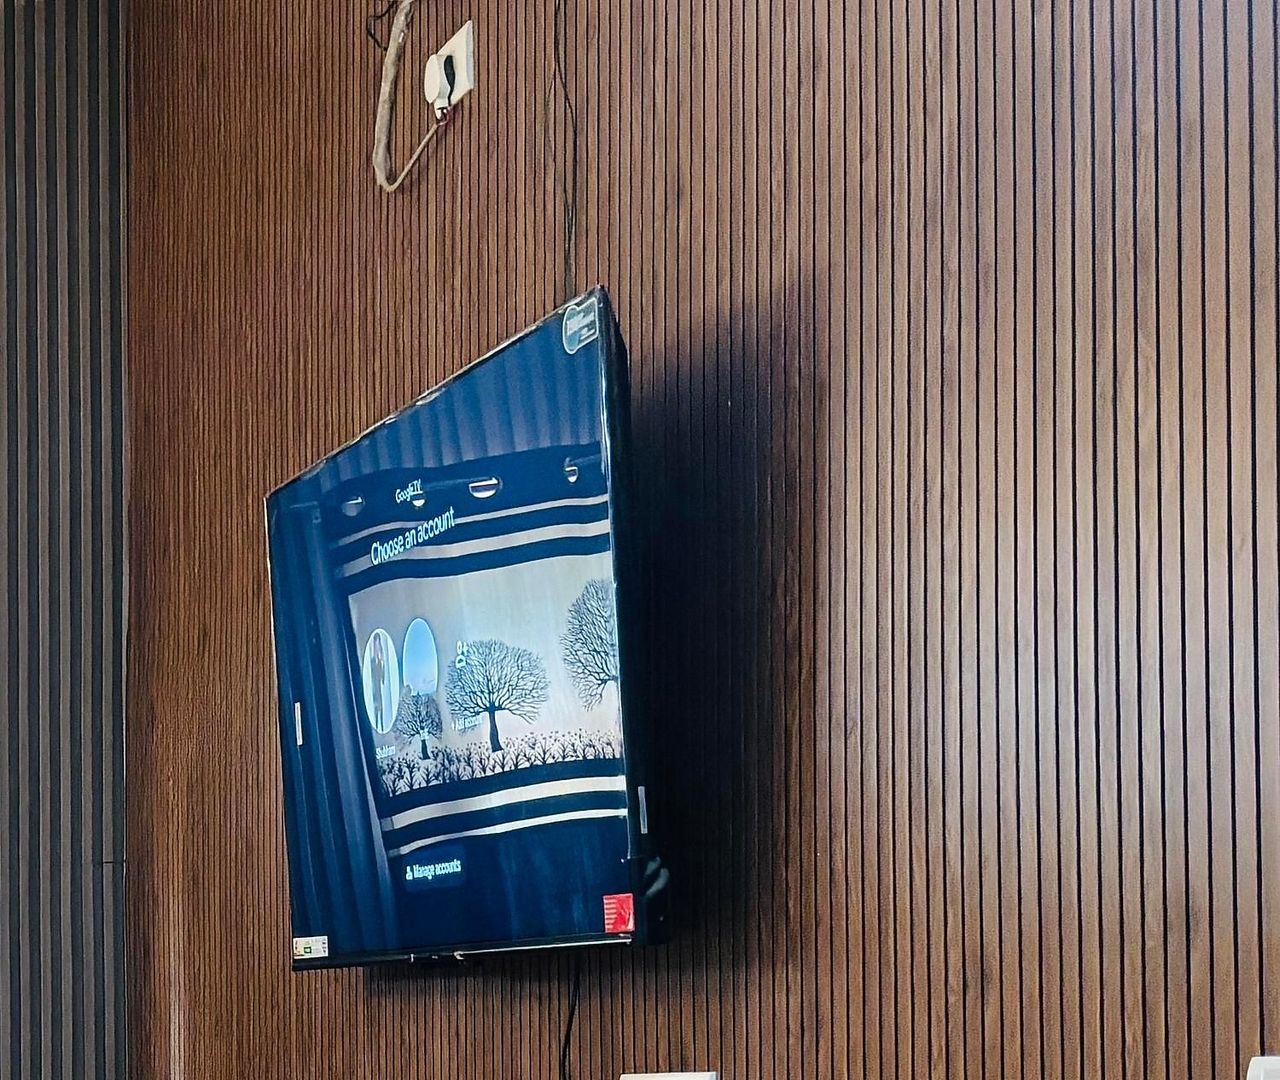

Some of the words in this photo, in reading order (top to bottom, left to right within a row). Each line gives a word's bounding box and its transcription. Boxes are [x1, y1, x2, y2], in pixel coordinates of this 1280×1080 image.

[371, 535, 404, 565] Choose
[405, 529, 417, 549] an
[417, 506, 455, 543] account
